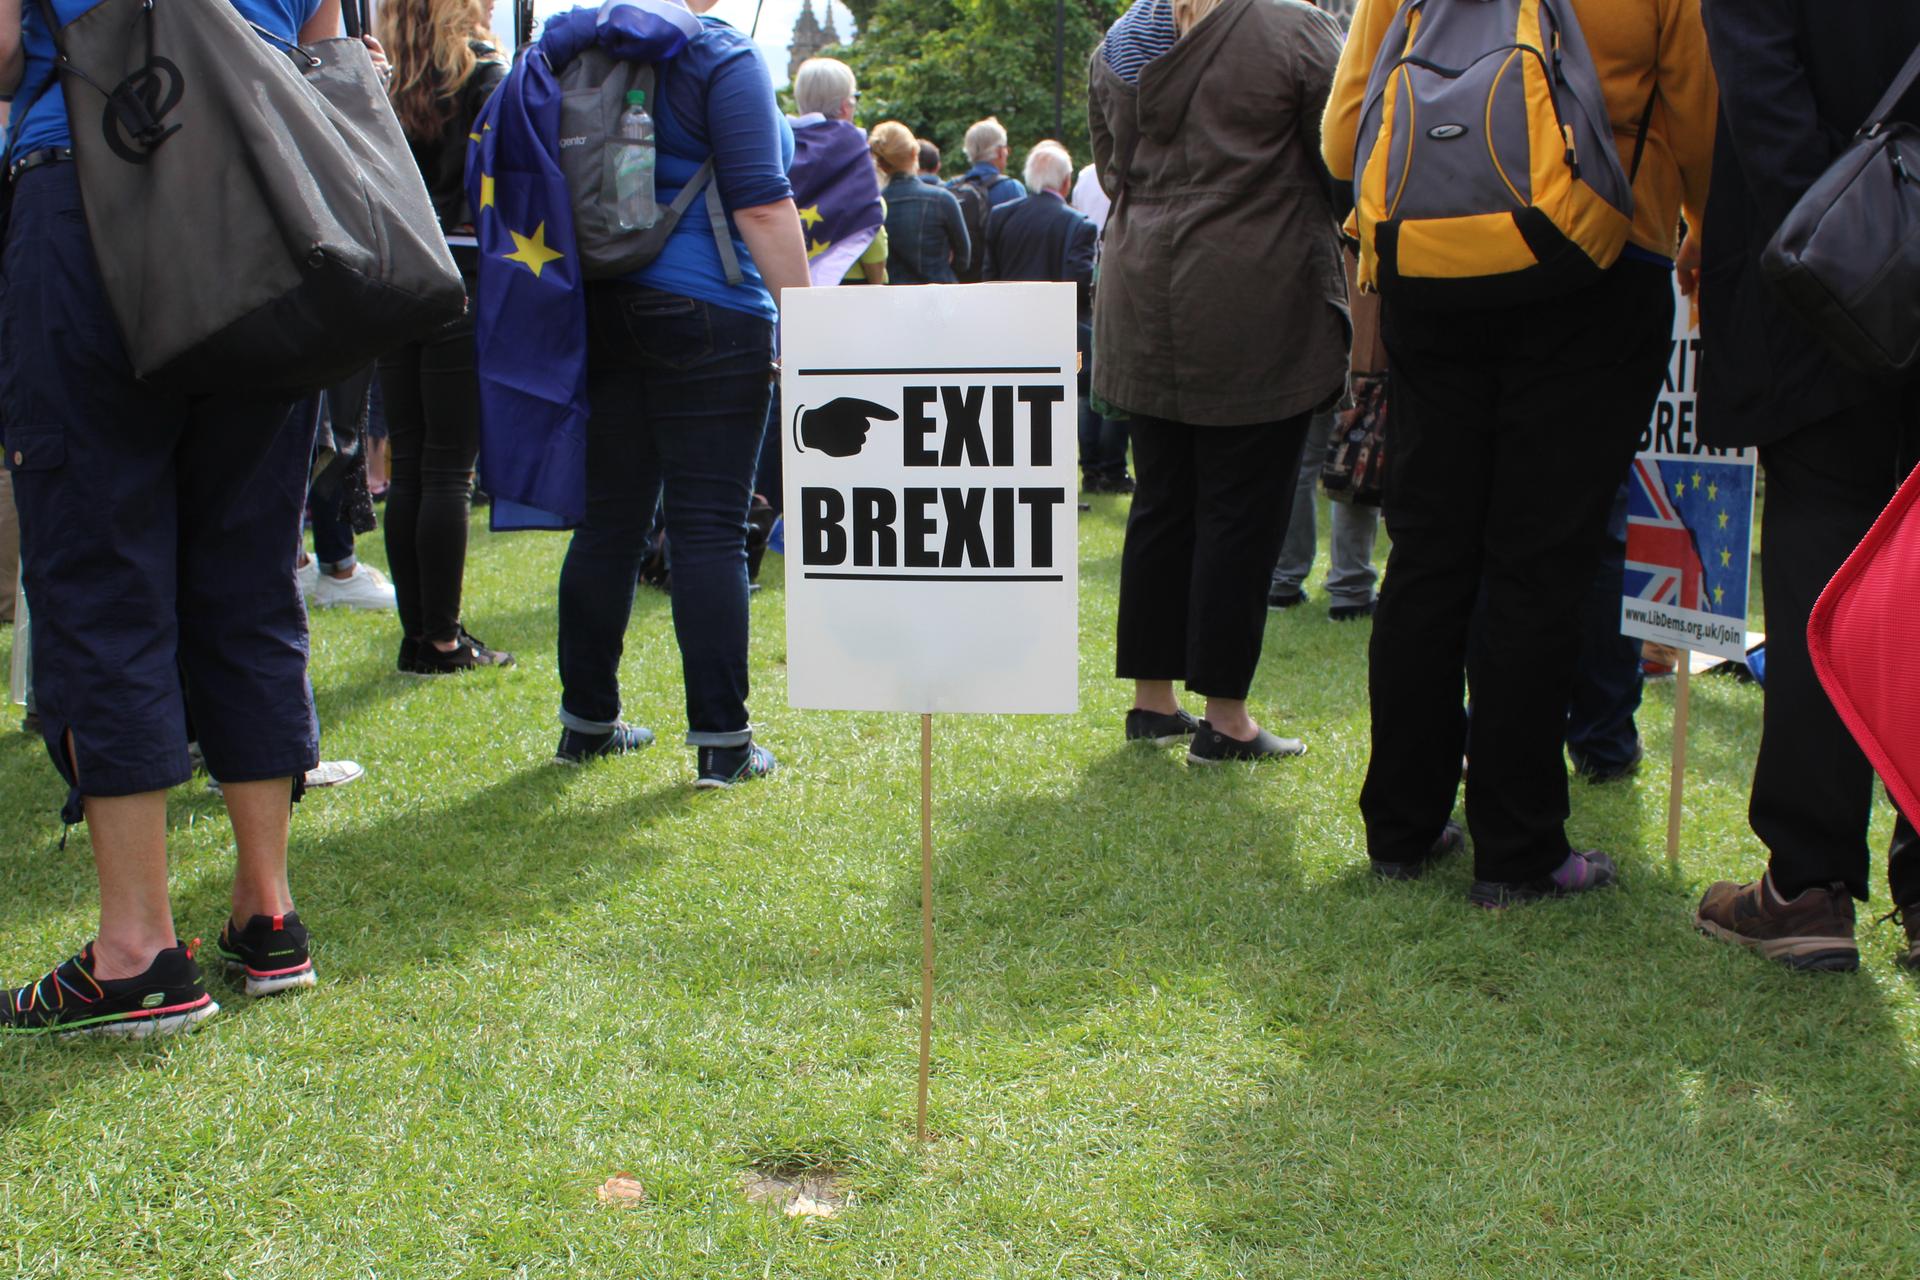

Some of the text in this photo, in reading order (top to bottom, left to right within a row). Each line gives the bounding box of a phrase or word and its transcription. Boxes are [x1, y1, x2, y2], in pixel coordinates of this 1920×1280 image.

[903, 385, 1064, 467] EXIT
[801, 487, 1065, 568] BREXIT
[1624, 607, 1741, 646] www.LibDems.org.uk/join
